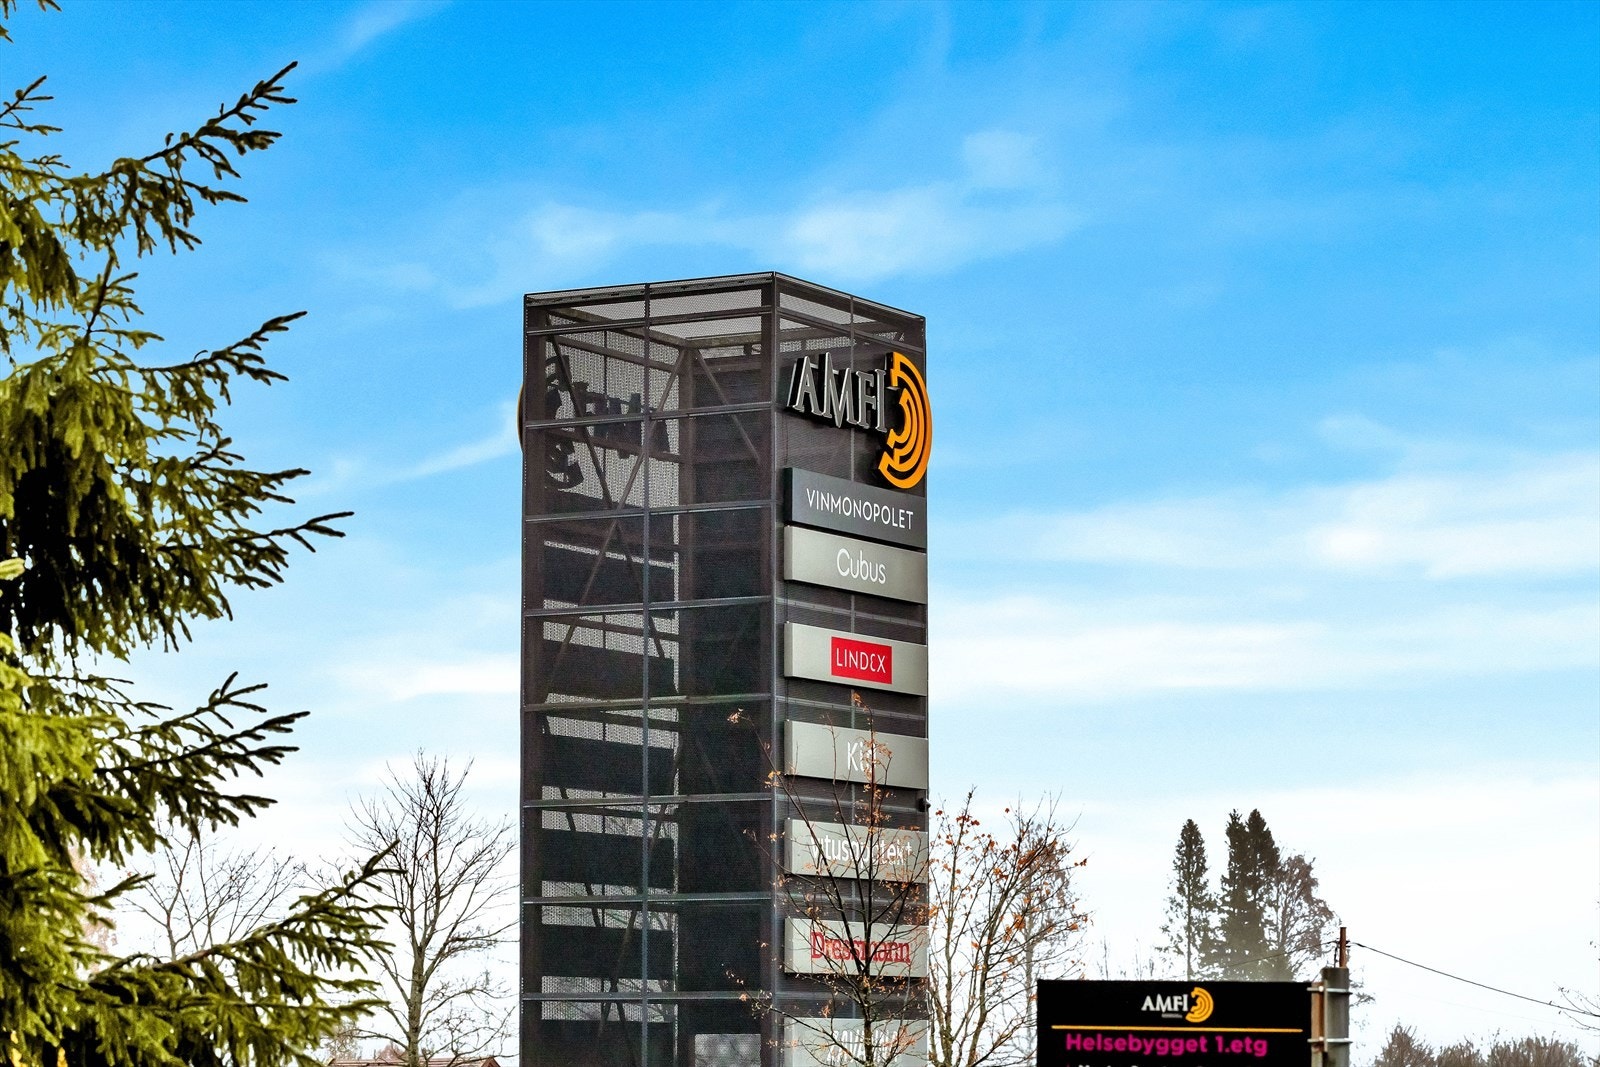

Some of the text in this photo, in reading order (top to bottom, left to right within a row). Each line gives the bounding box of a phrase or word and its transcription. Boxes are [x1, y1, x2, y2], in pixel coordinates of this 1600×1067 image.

[790, 352, 888, 433] AMFI
[806, 488, 914, 530] VINMONOPOLET
[836, 547, 887, 585] Cubus
[836, 647, 886, 674] LINDEX
[1141, 993, 1189, 1013] AMFI
[1065, 1033, 1268, 1057] Helsebygget 1.etg
